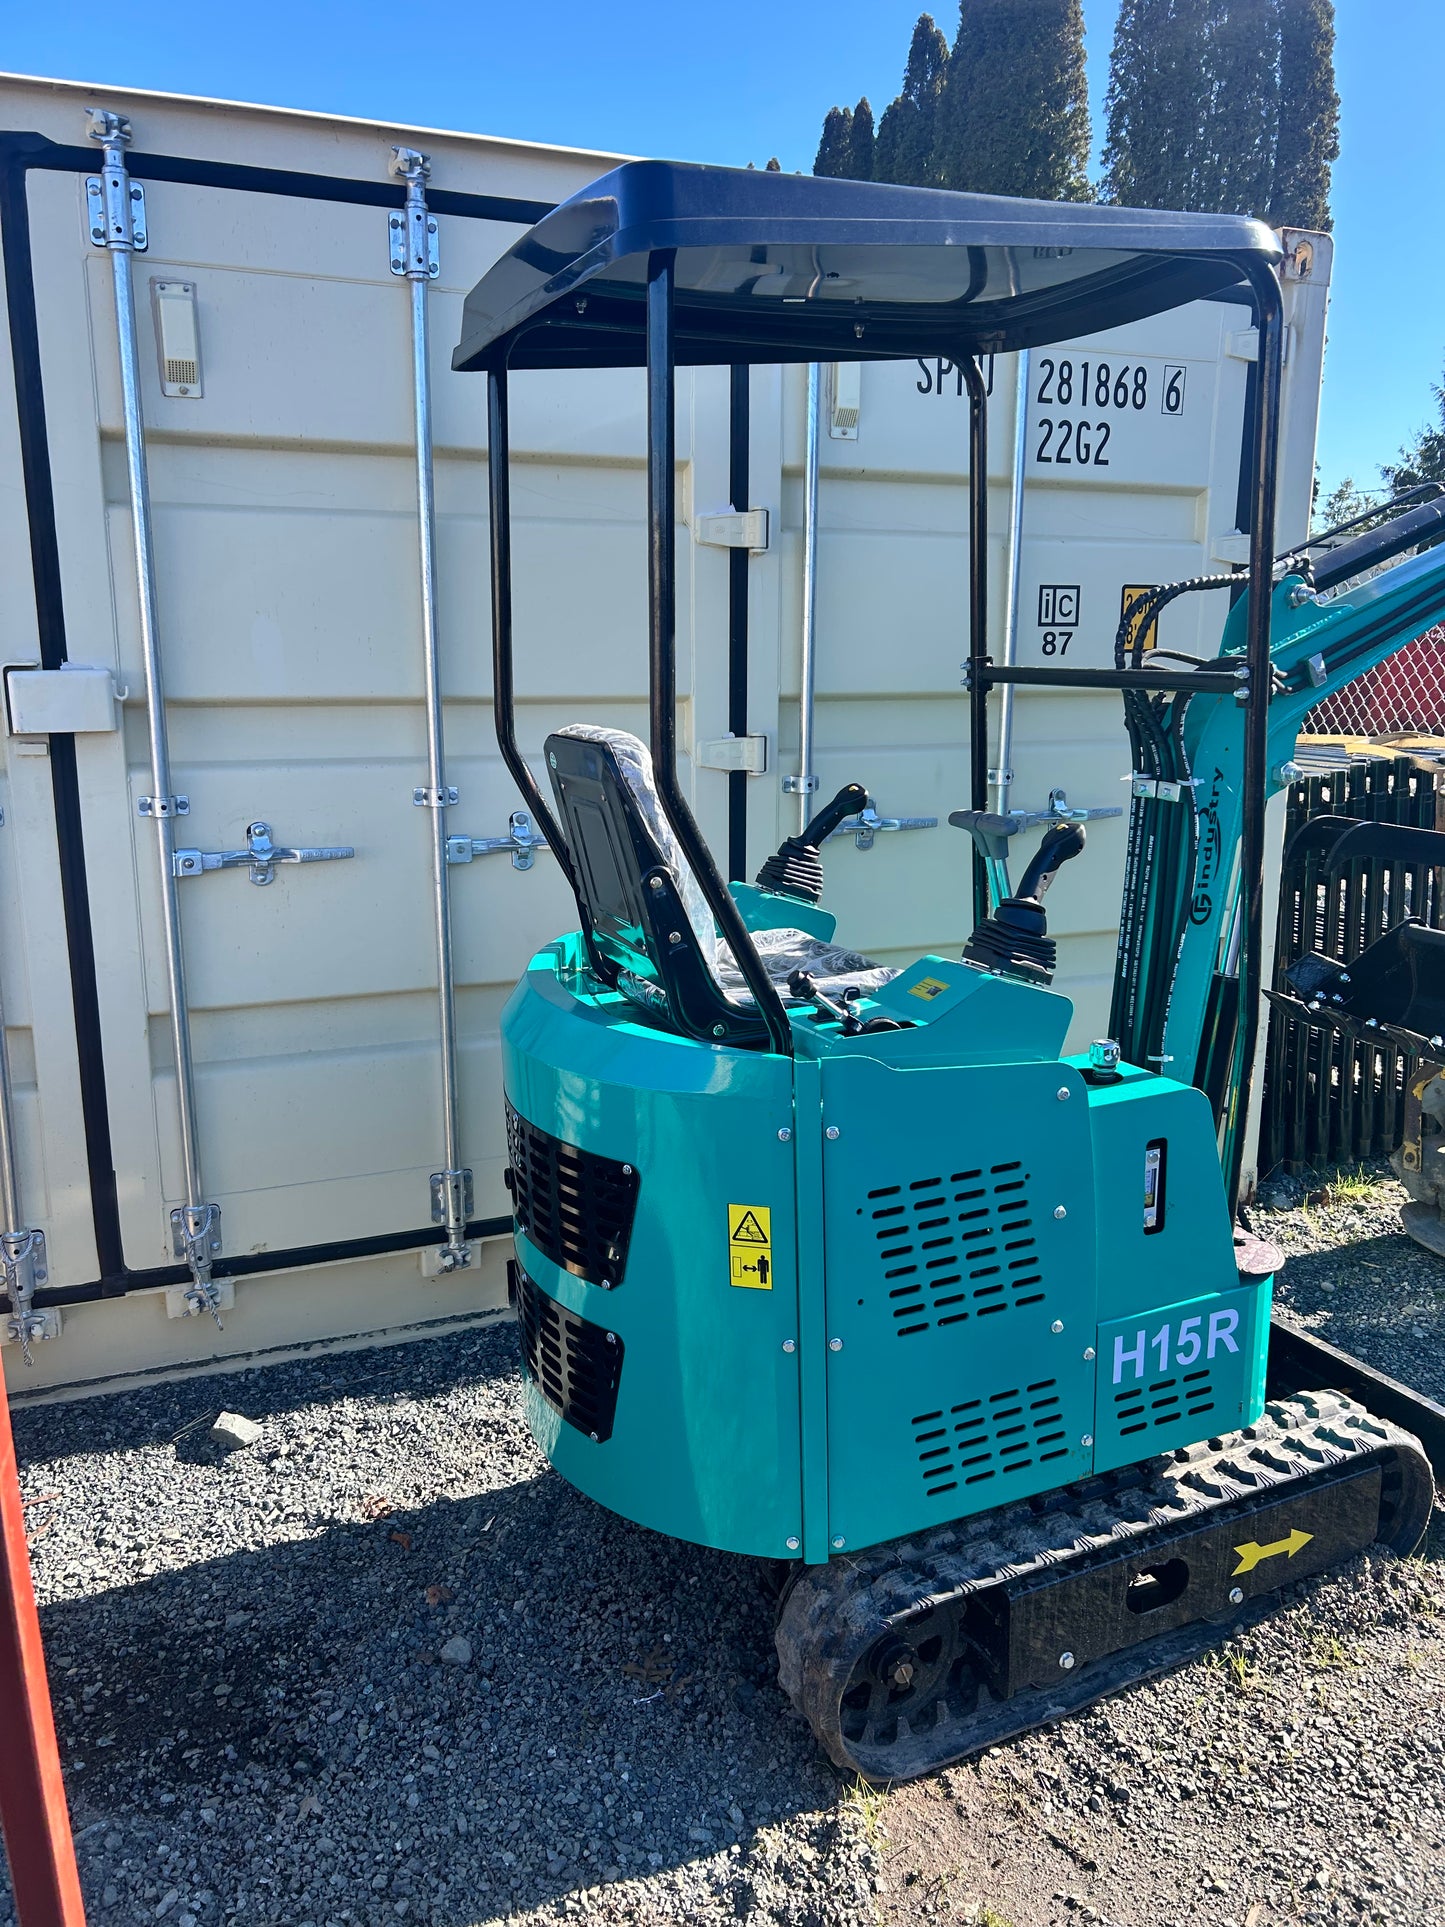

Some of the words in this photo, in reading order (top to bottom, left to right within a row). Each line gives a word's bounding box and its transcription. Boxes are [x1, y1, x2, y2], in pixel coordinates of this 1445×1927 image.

[1037, 358, 1148, 411] 281868
[1165, 369, 1184, 413] 6
[1036, 418, 1112, 466] 22G2
[1042, 631, 1074, 656] 87
[1112, 1308, 1240, 1385] H15R
